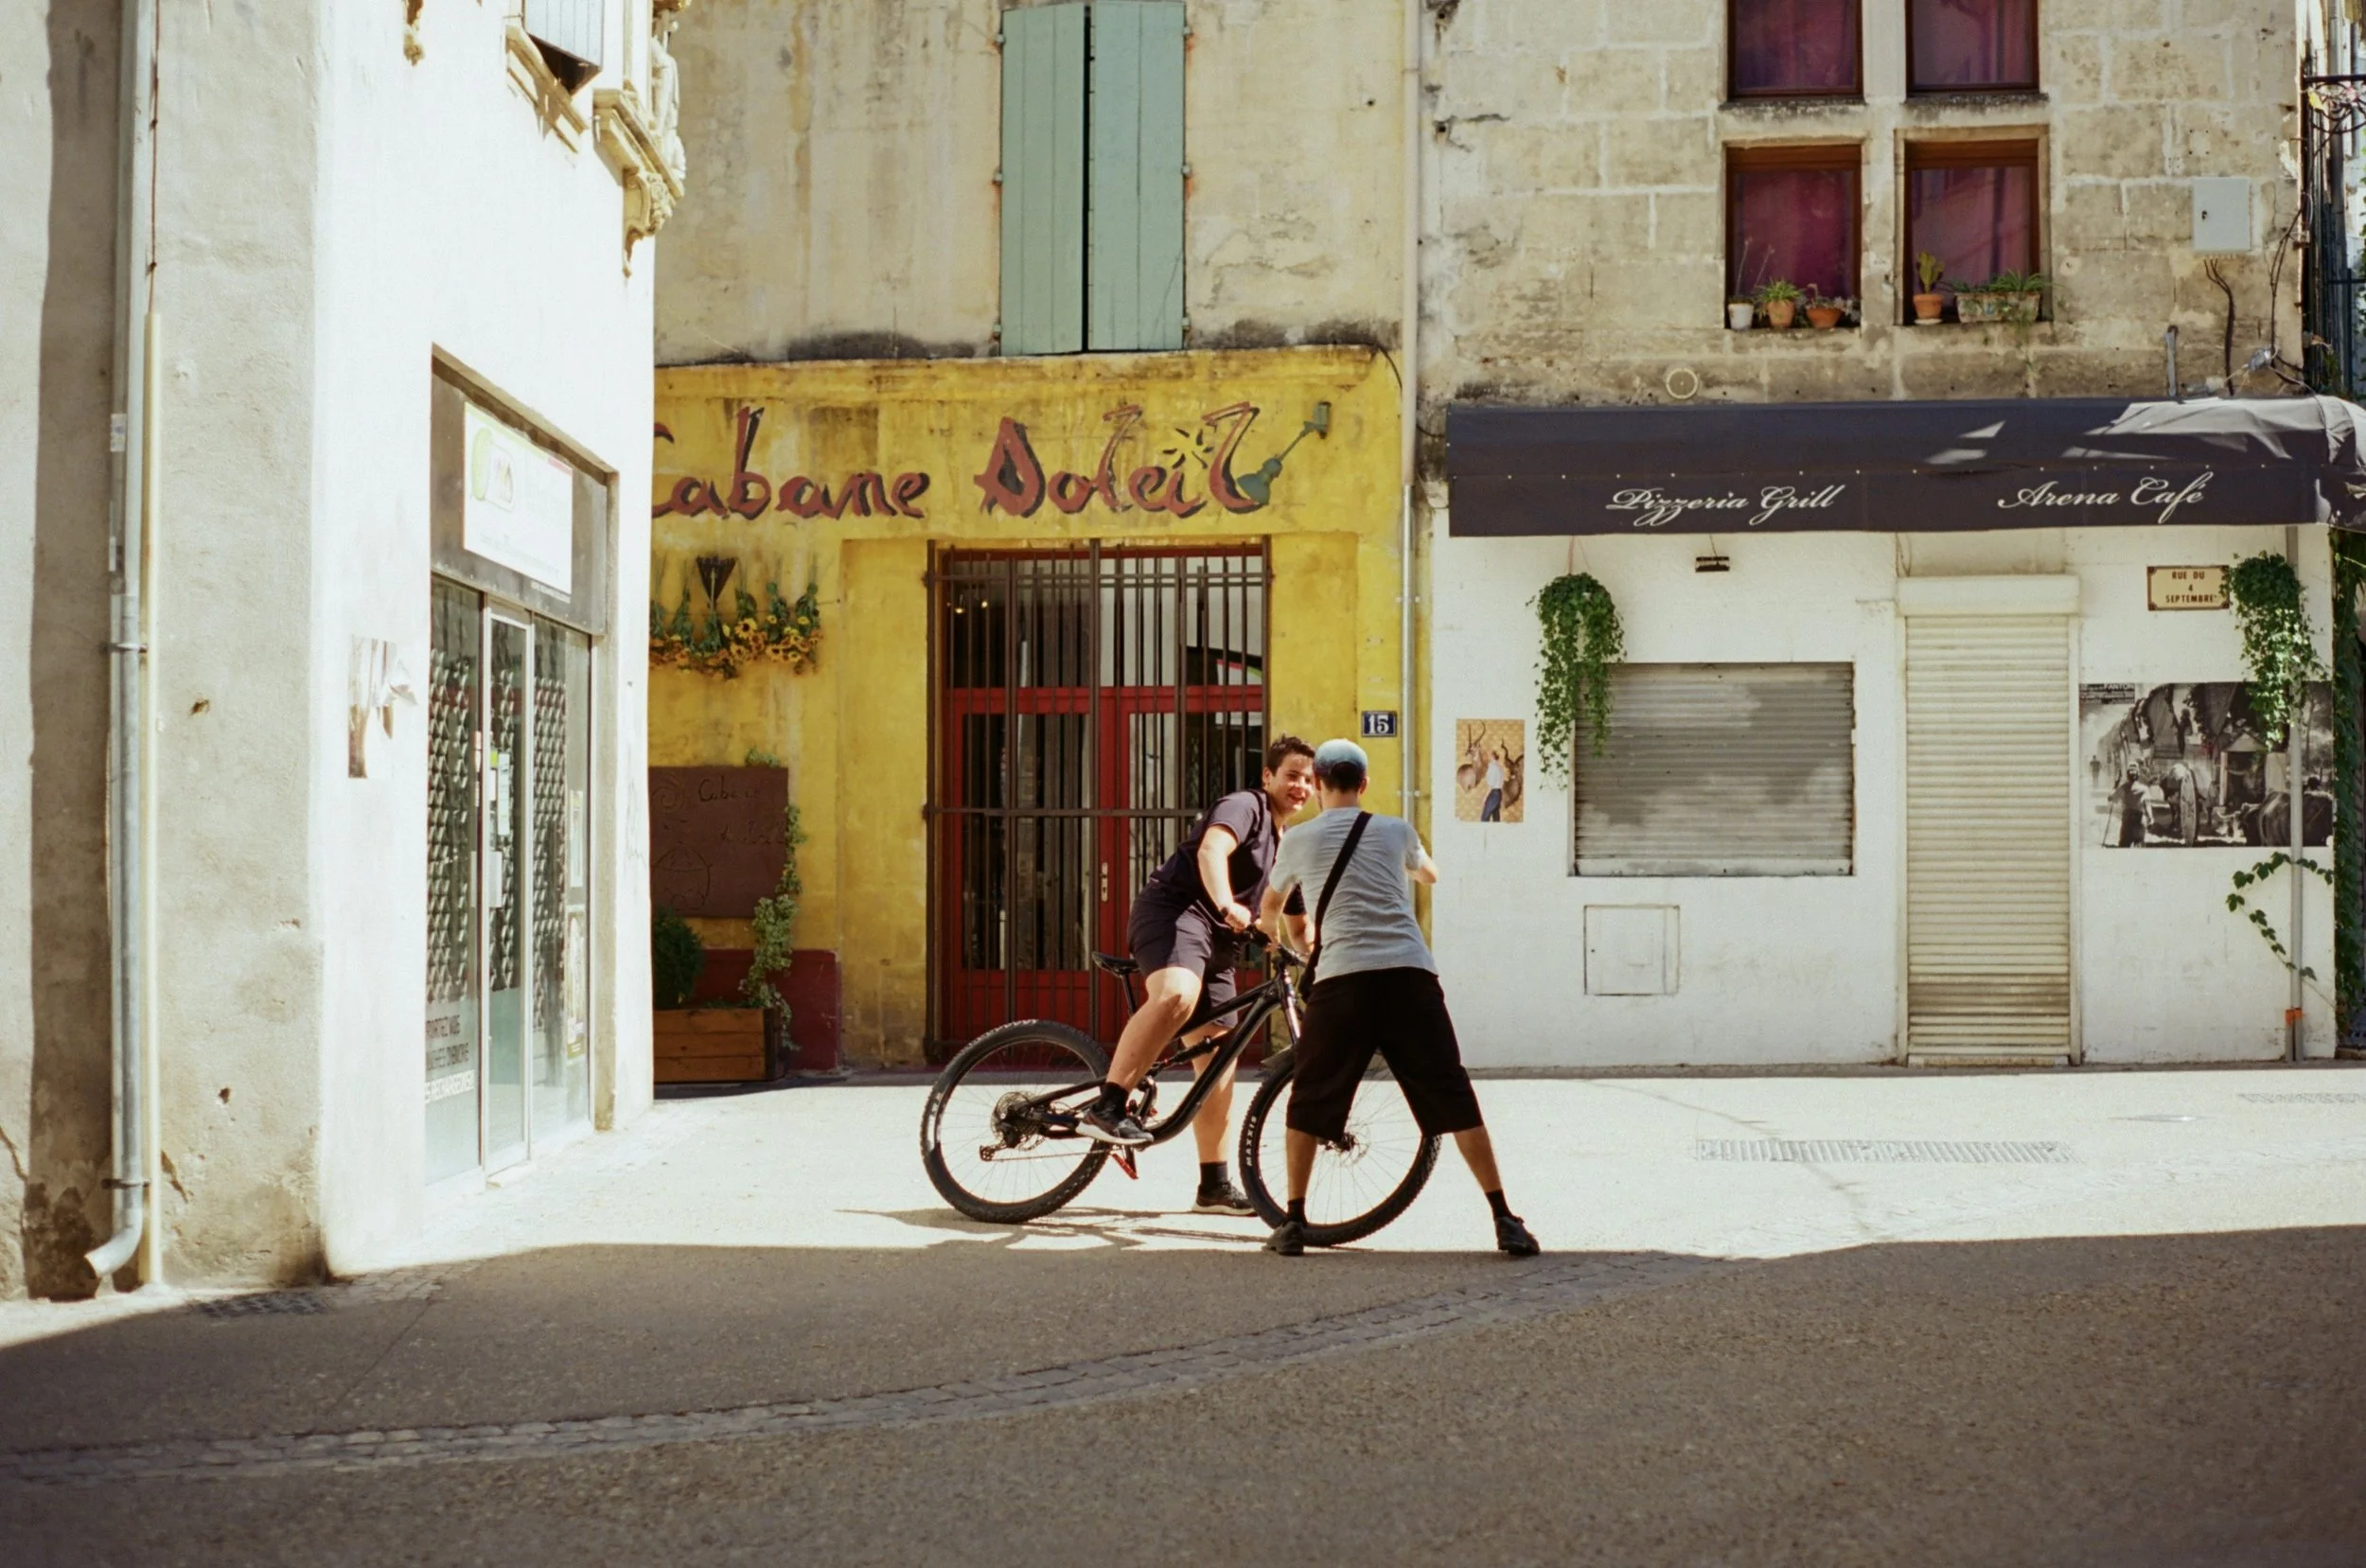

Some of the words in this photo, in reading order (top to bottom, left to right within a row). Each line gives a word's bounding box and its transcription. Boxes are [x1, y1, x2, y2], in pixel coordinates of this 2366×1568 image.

[973, 401, 1262, 519] Soleil
[1605, 487, 1749, 527] Pizzeria
[1748, 484, 1846, 526] Grill
[1997, 481, 2121, 509] Arena
[2129, 471, 2215, 524] Café
[2171, 571, 2187, 580] RUE
[2193, 571, 2205, 580] DU
[2187, 584, 2194, 592] 4
[2164, 594, 2214, 604] SEPTEMBRE
[1368, 714, 1389, 734] 15
[1245, 1116, 1257, 1167] MAXXIS
